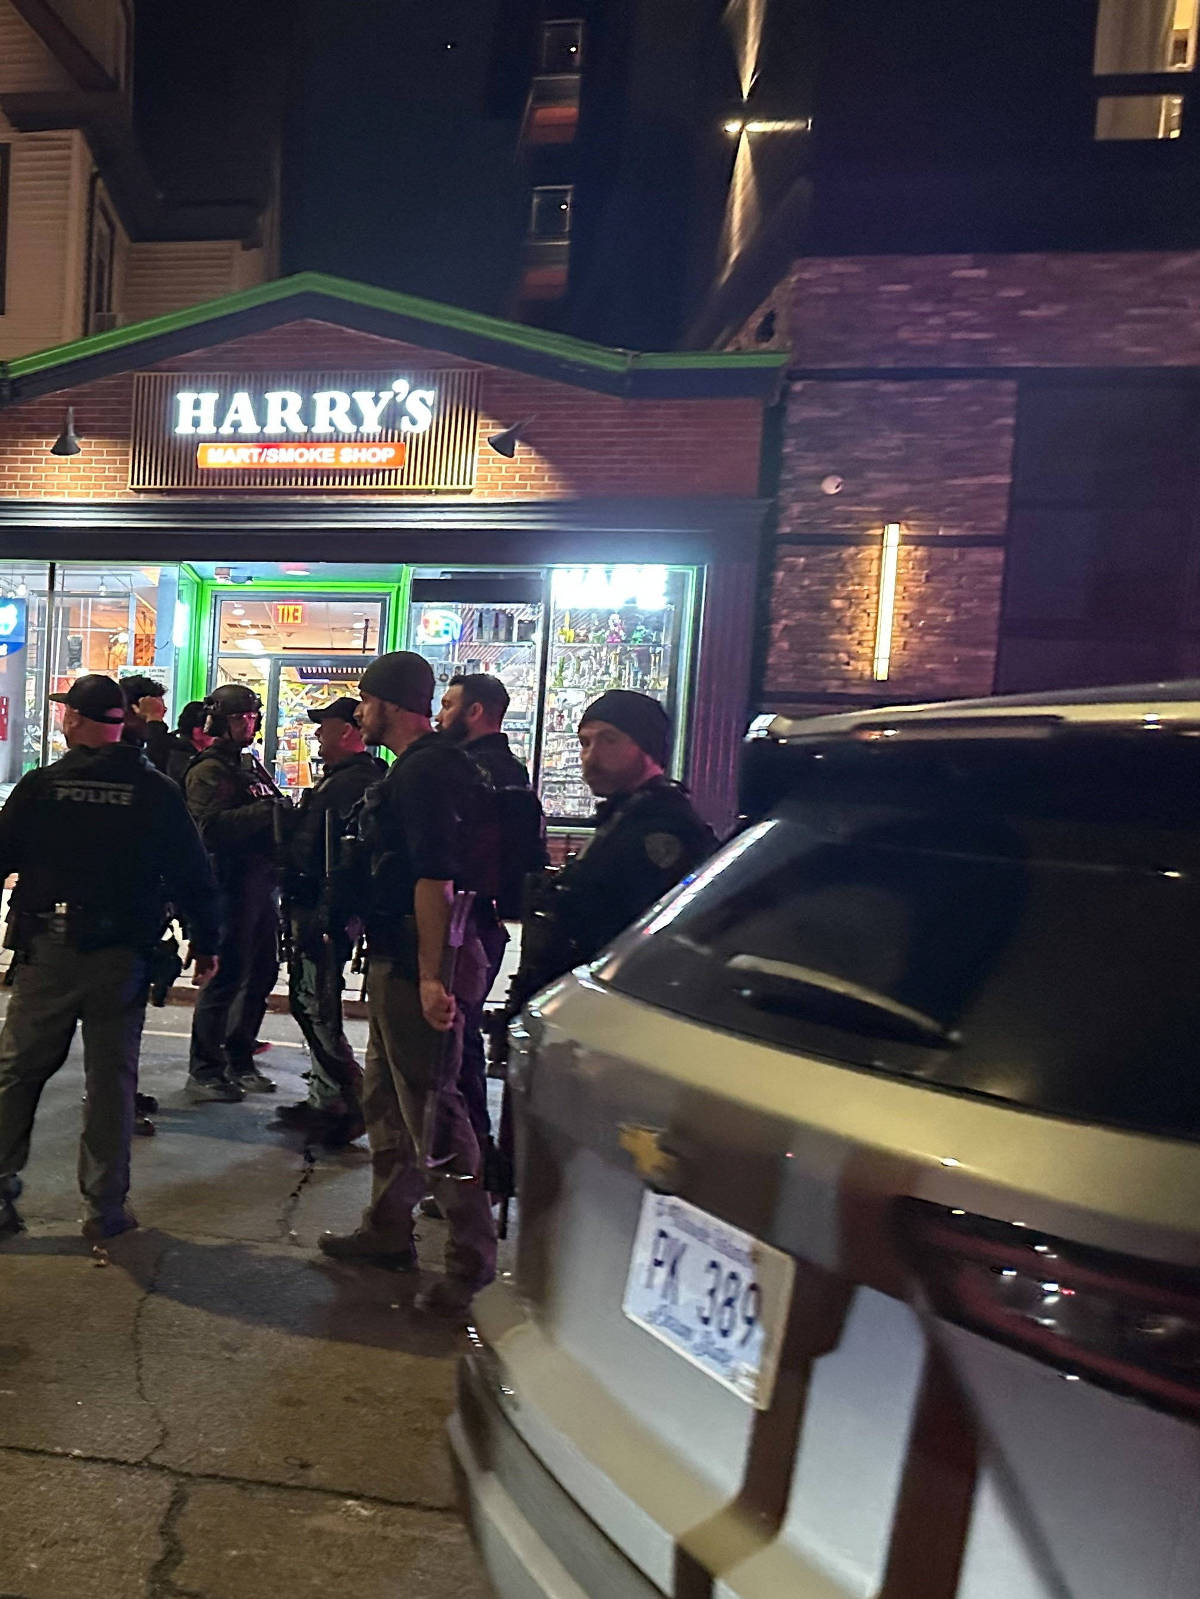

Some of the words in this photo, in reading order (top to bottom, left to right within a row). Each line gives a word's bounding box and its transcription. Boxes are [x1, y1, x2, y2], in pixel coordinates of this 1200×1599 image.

[175, 379, 435, 434] HARRY'S
[207, 447, 335, 464] MART/SMOKE
[339, 446, 396, 464] SHOP
[56, 787, 133, 806] POLICE
[697, 1260, 762, 1347] 389
